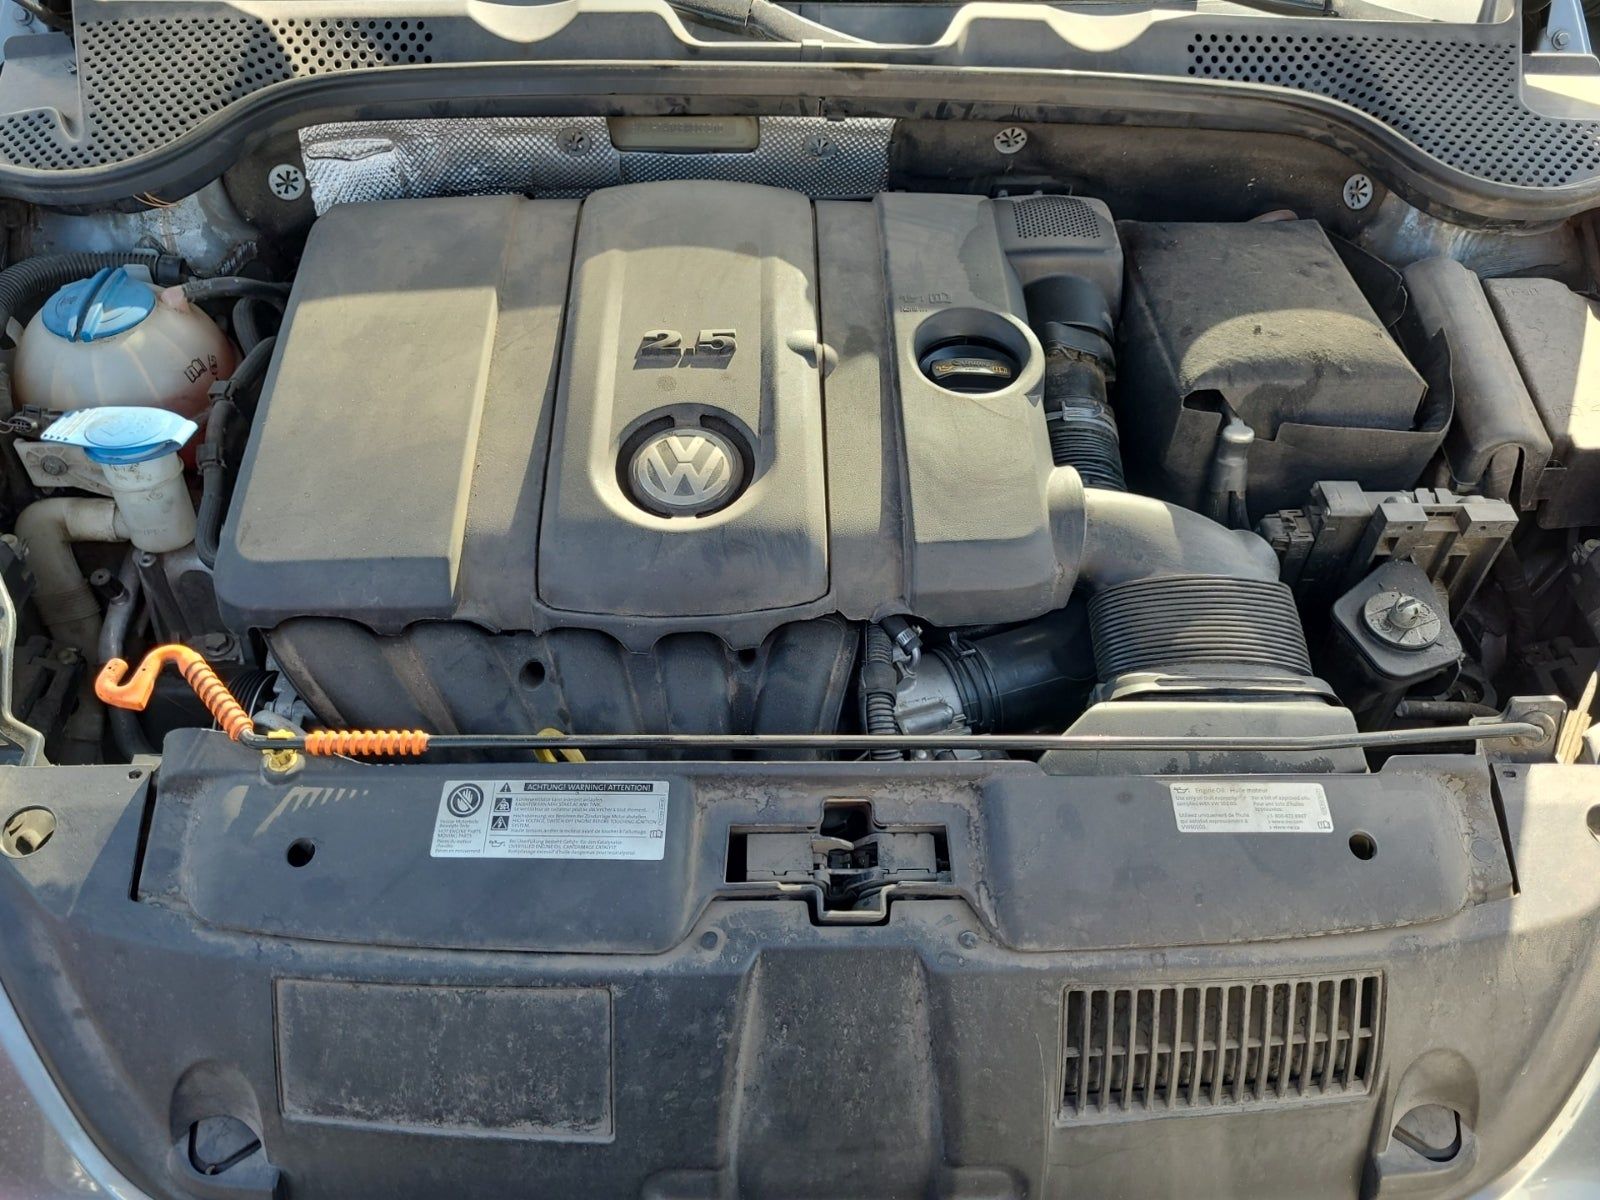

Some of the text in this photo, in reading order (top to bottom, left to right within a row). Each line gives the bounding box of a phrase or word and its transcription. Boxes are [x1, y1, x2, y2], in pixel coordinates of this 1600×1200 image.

[635, 329, 738, 357] 2.5
[527, 783, 652, 792] ACHTUNG! WARNING! ATTENTION!
